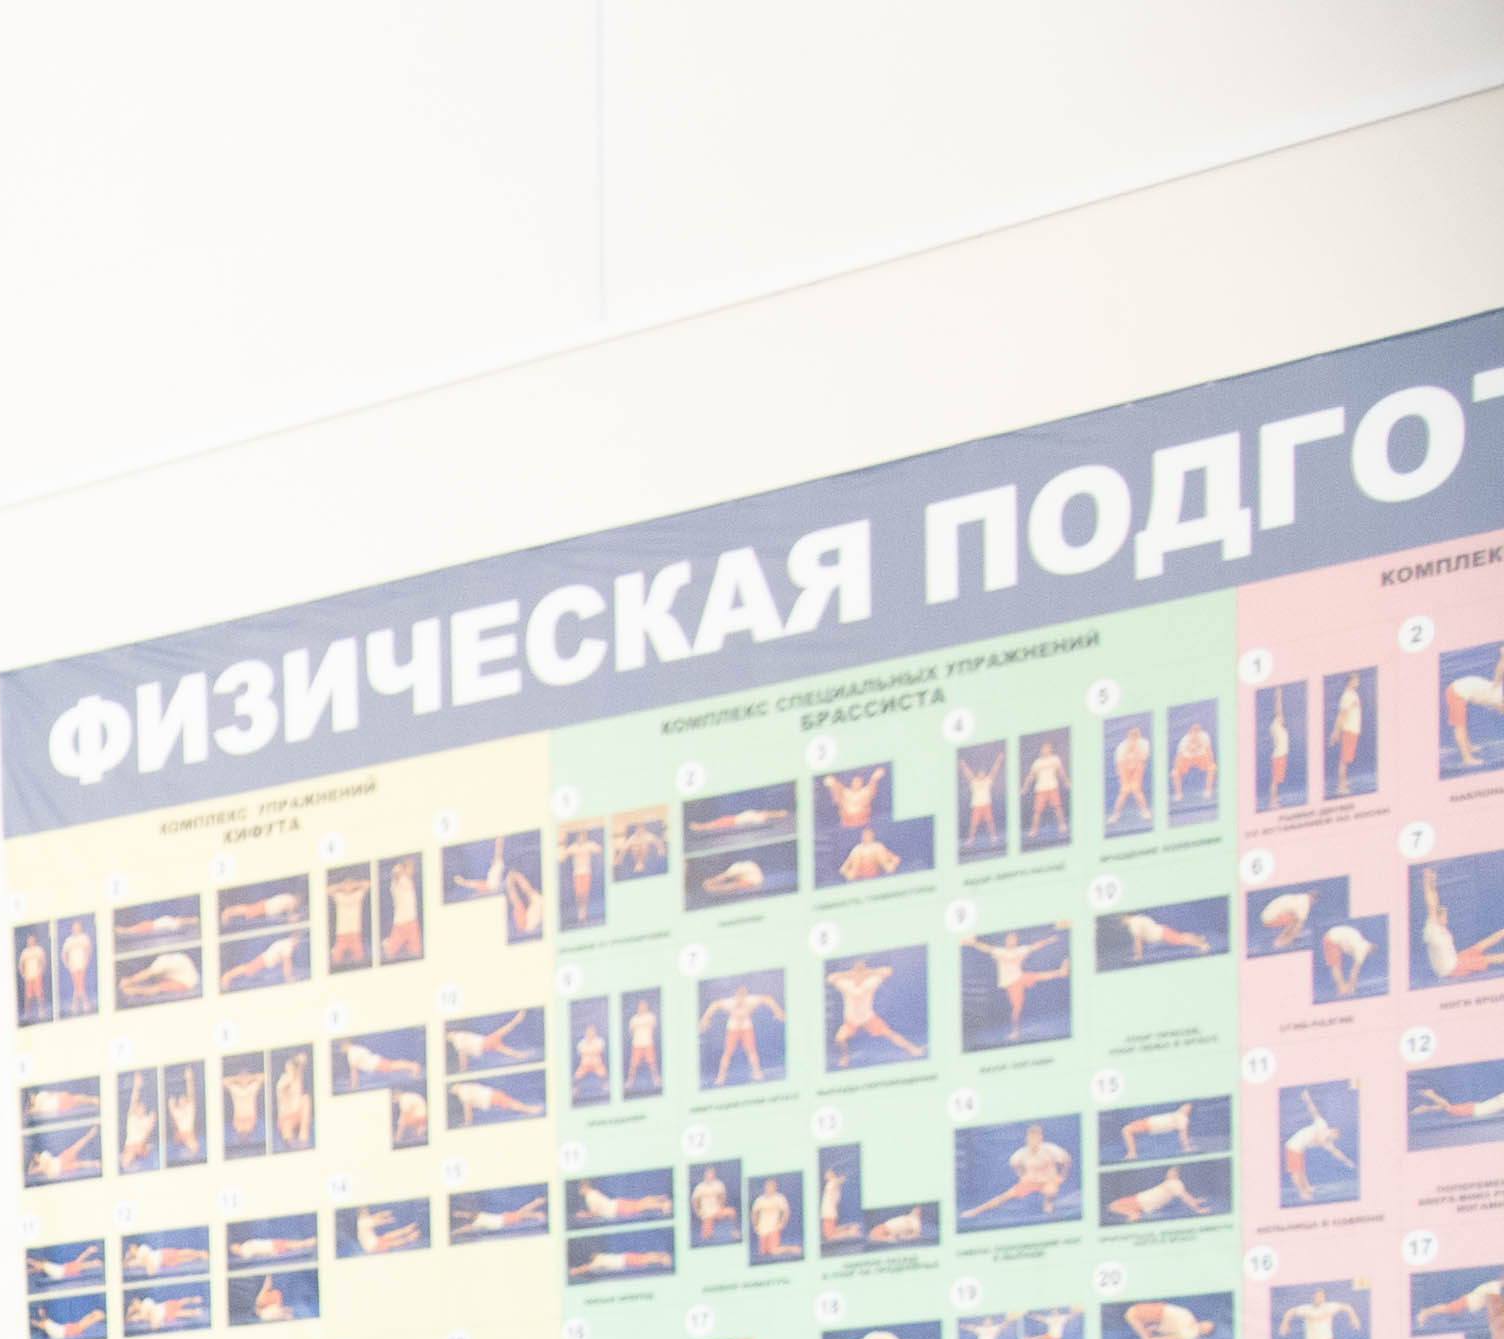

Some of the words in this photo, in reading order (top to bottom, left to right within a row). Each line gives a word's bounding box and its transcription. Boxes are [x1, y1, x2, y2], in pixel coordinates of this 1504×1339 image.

[1411, 625, 1423, 644] 2
[48, 518, 871, 785] ФИЗИЧЕСКАЯ
[1252, 657, 1262, 673] 1
[660, 701, 768, 736] КОМПЛЕКС
[775, 666, 937, 713] СПЕЦИАЛЬНЫХ
[945, 630, 1101, 678] УПРАЖНЕНИЙ
[799, 687, 946, 732] БРАССИСТА
[160, 807, 248, 835] КОМПЛЕКС
[259, 775, 377, 816] УПРАЖНЕНИЙ
[1412, 830, 1423, 847] 7
[1251, 857, 1264, 876] 6
[1096, 882, 1117, 900] 10
[1408, 1034, 1431, 1053] 12
[1248, 1056, 1268, 1073] 11
[1098, 1076, 1120, 1094] 15
[955, 1097, 974, 1111] 14
[817, 1114, 838, 1130] 13
[687, 1132, 707, 1149] 12
[1409, 1237, 1433, 1256] 17
[1251, 1255, 1273, 1271] 16
[1100, 1269, 1121, 1287] 20
[957, 1284, 978, 1300] 19
[823, 1299, 840, 1314] 18
[691, 1311, 710, 1325] 17
